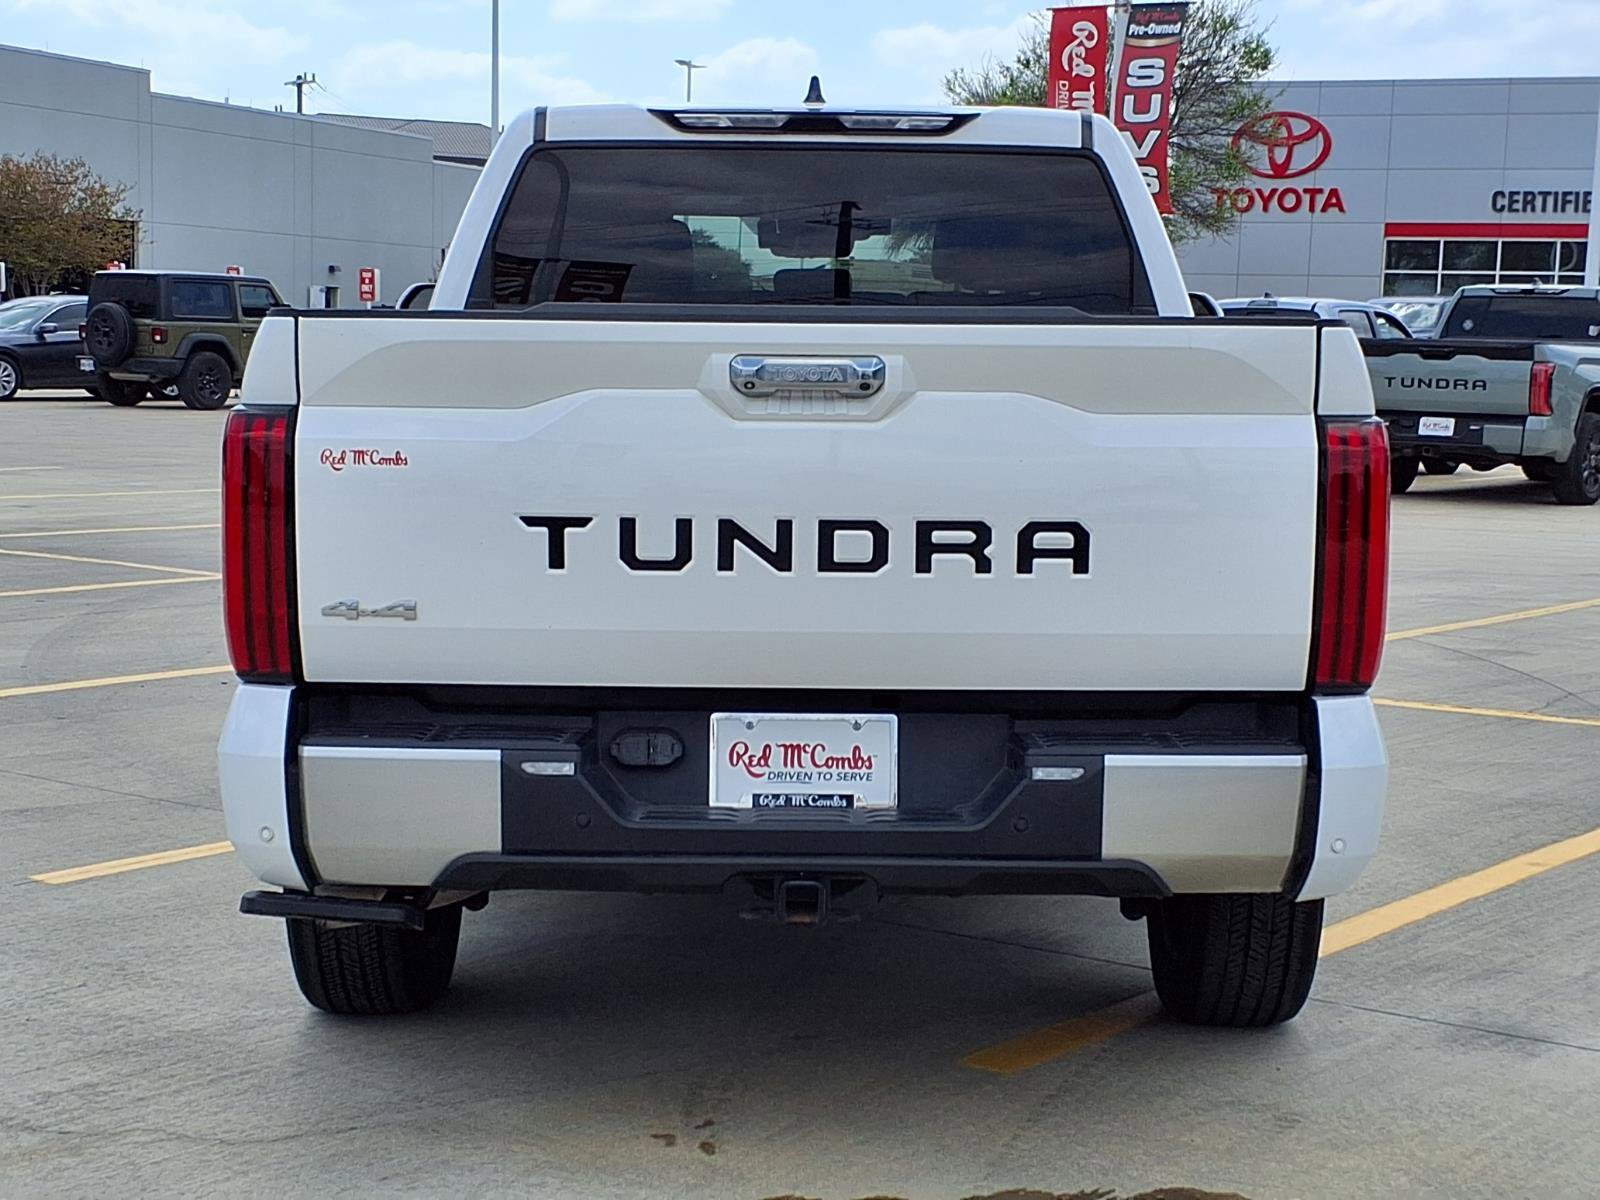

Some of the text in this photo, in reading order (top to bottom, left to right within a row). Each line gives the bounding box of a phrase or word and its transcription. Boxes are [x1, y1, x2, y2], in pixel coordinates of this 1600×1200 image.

[1128, 22, 1182, 36] Pre-Owned
[1062, 21, 1099, 78] Red
[1210, 187, 1346, 214] TOYOTA
[1491, 190, 1592, 213] CERTIFIE
[774, 367, 843, 381] TOYOTA
[1384, 376, 1487, 391] TUNDRA
[320, 448, 408, 471] Red McCombs
[516, 515, 1092, 577] TUNDRA
[729, 741, 873, 778] Red McCombs
[767, 771, 873, 782] DRIVEN TO SERVE
[759, 794, 847, 808] Red McCombs
